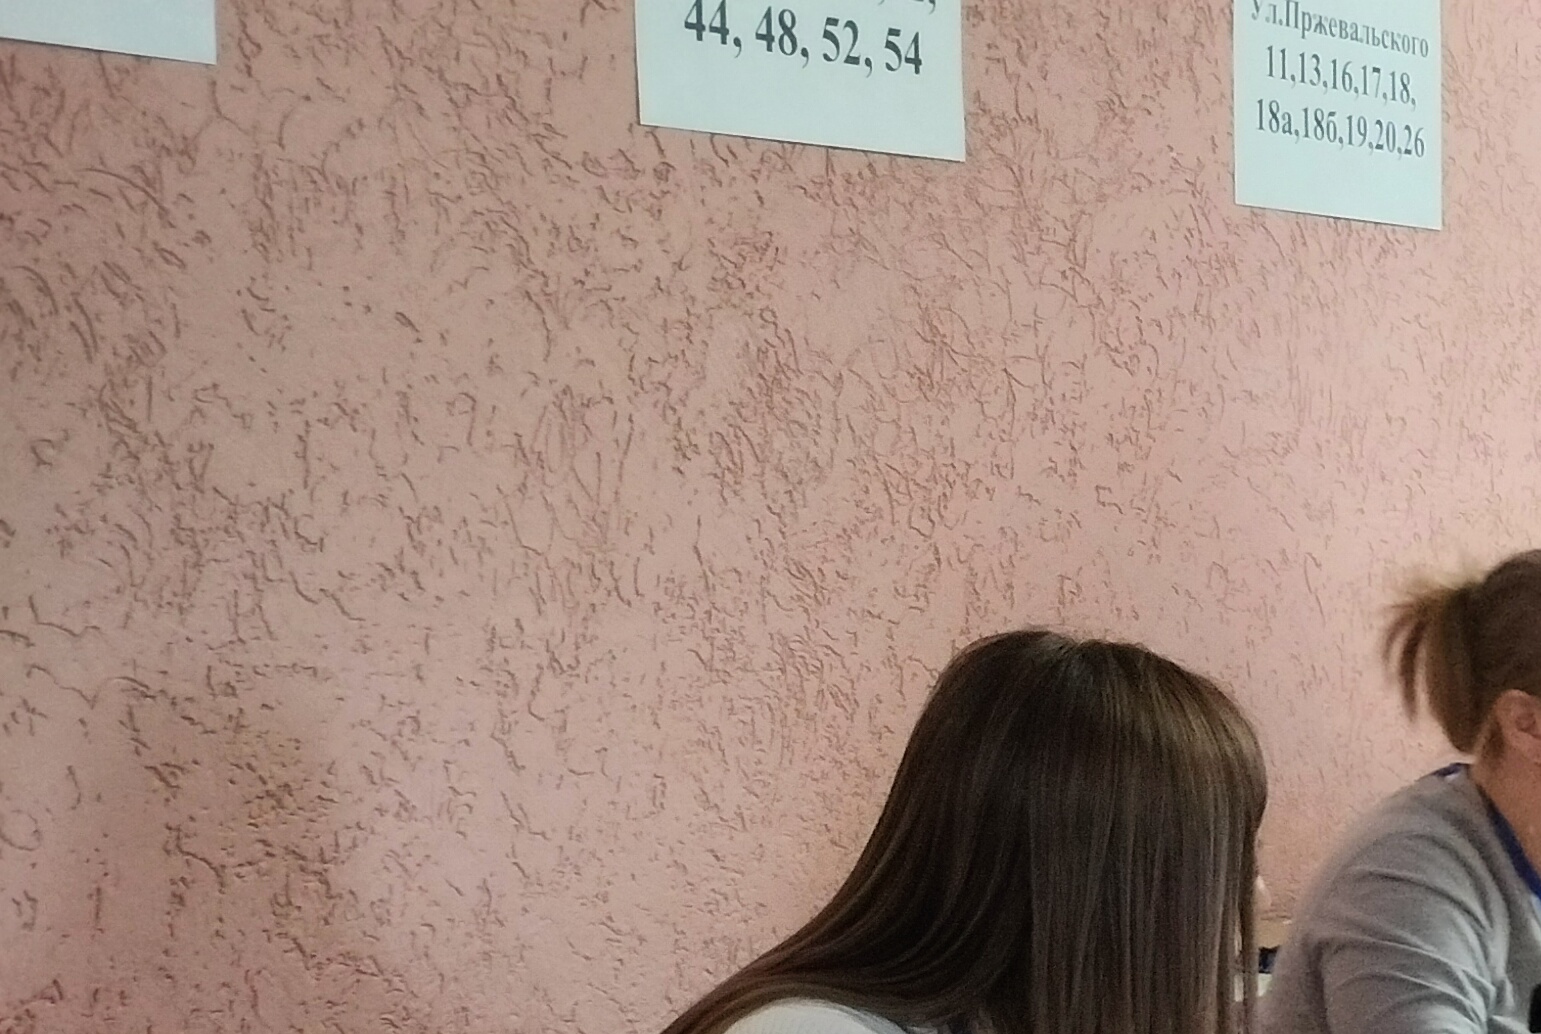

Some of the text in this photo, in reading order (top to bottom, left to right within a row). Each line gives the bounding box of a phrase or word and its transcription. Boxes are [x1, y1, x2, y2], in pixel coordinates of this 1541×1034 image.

[684, 0, 923, 77] 44, 48, 52, 54
